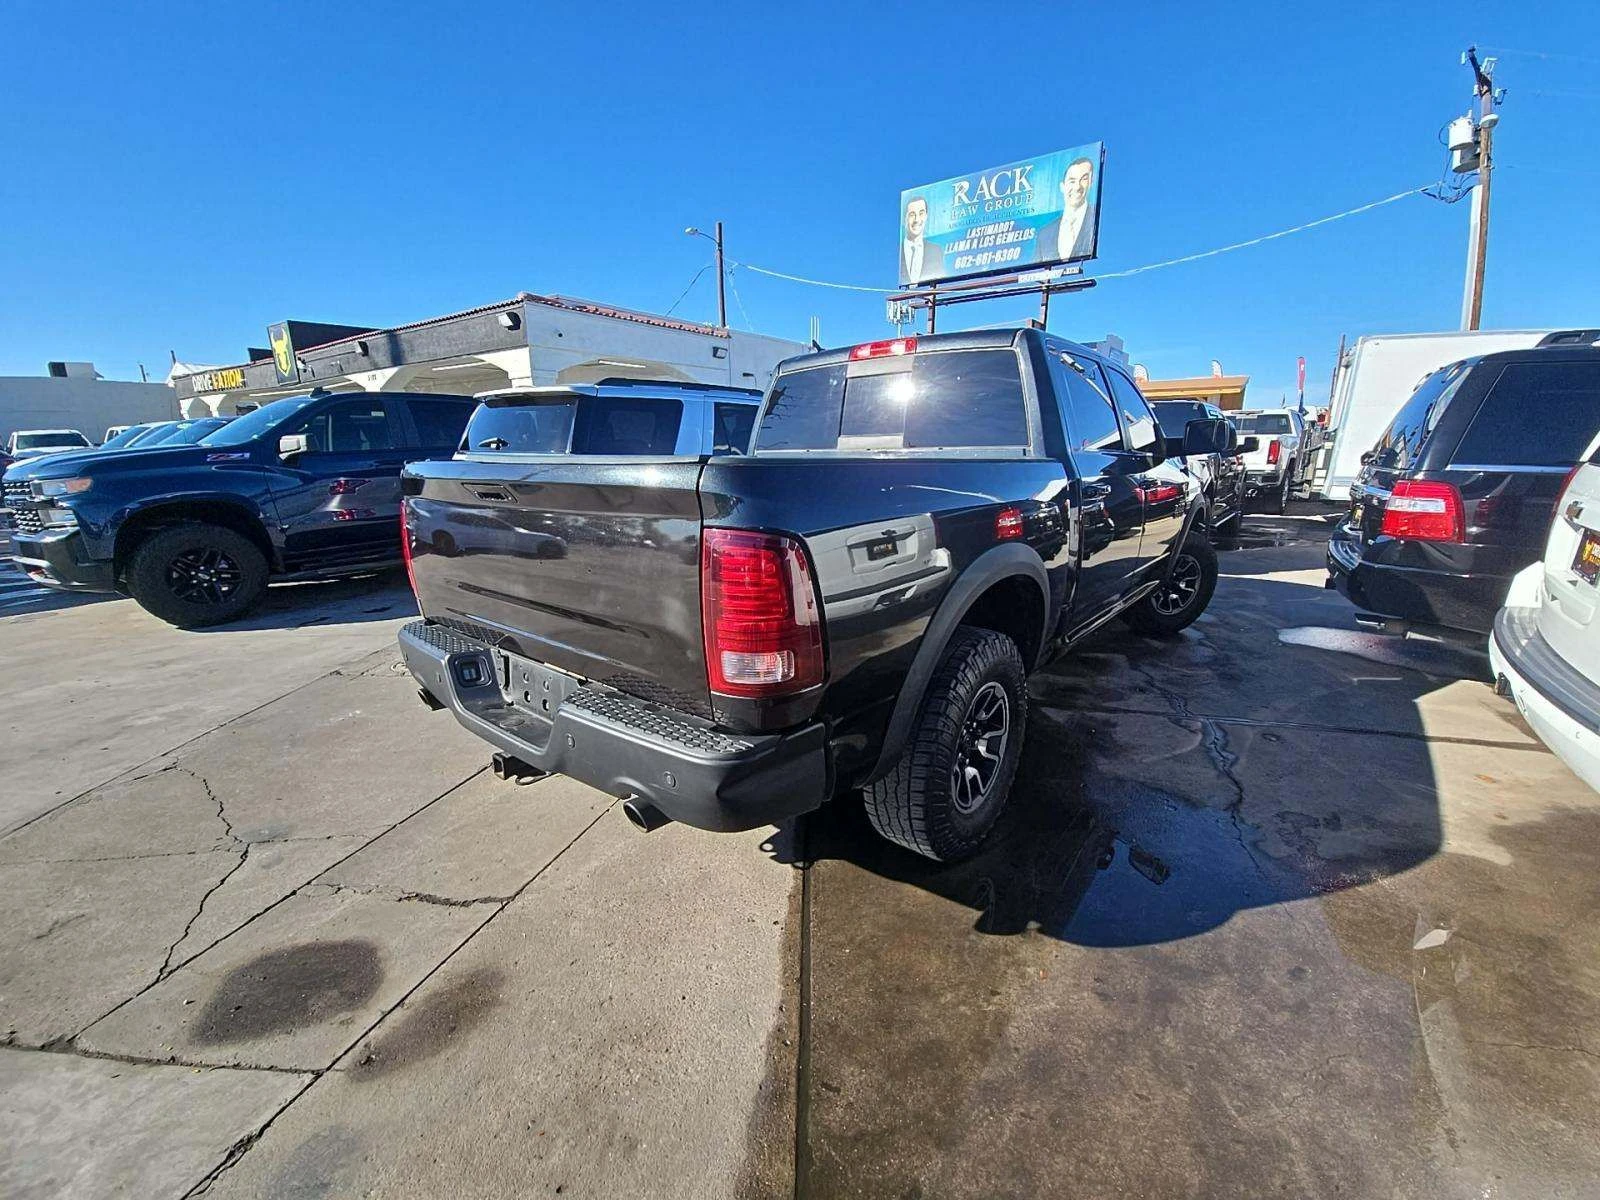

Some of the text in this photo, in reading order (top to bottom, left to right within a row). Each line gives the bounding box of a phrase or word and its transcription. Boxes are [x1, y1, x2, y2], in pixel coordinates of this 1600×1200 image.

[952, 165, 1034, 207] RACK
[951, 204, 979, 219] LAW
[985, 193, 1033, 212] GROUP
[944, 238, 973, 254] LLAMA
[979, 235, 995, 248] LOS
[996, 227, 1036, 245] GEMELOS
